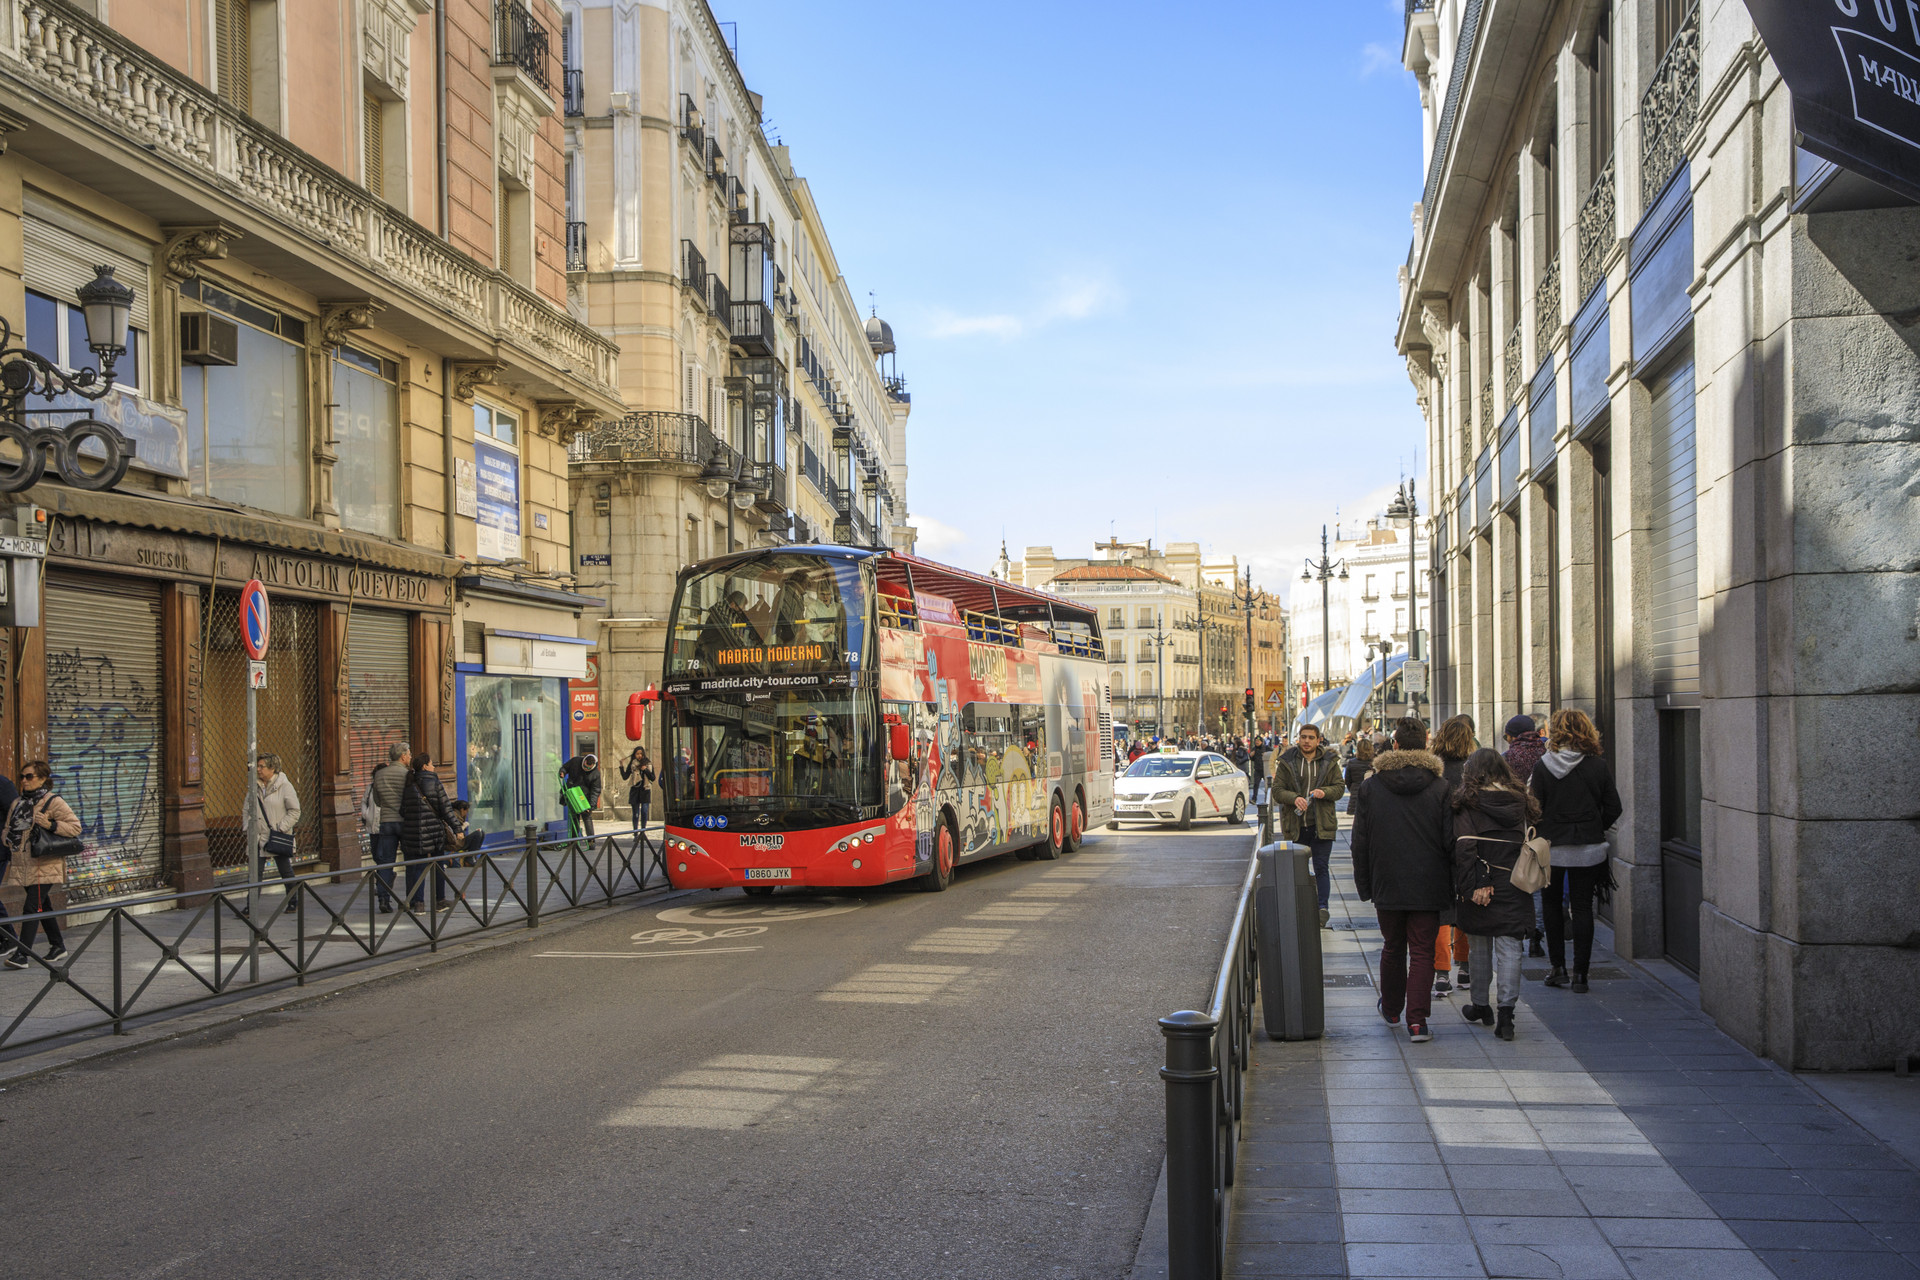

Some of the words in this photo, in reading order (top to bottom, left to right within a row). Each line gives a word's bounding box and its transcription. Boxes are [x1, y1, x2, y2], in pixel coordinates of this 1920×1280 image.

[137, 548, 189, 571] SUCESOR
[252, 552, 340, 593] ANTOLIN
[718, 648, 763, 665] MADRID
[767, 645, 822, 663] MODERNO
[844, 652, 859, 662] 78
[687, 659, 700, 670] 78
[968, 643, 1007, 681] MADRID
[187, 640, 200, 728] LANERIA
[701, 675, 819, 690] madrid.city-tour.com
[574, 694, 596, 702] ATM
[740, 835, 784, 846] MADRID
[750, 870, 771, 878] 0860
[774, 869, 789, 878] JYK
